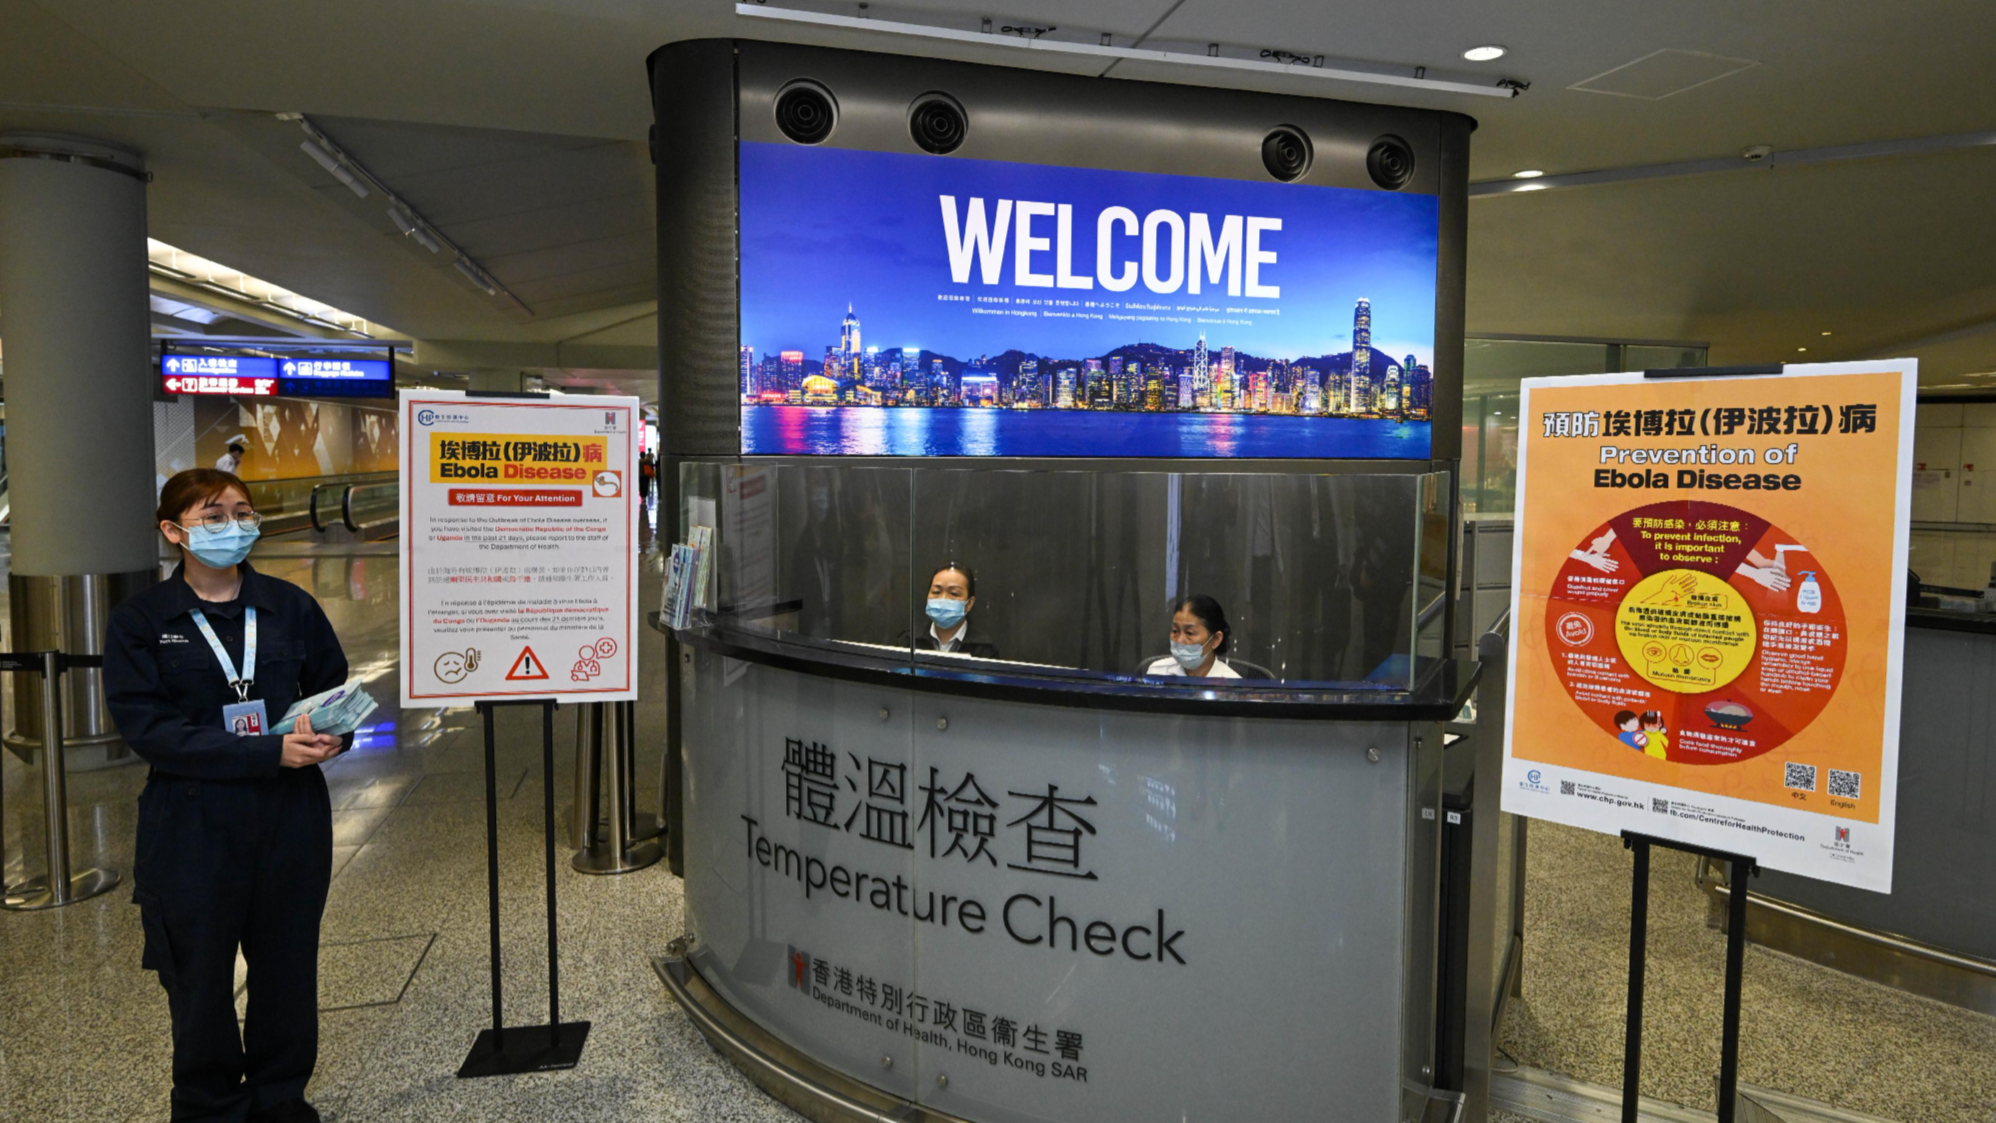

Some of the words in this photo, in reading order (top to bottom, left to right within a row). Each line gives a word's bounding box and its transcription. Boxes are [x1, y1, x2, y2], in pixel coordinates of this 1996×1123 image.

[939, 195, 1282, 298] WELCOME
[1600, 444, 1756, 464] Prevention
[1764, 443, 1798, 464] of
[440, 463, 498, 479] Ebola
[504, 464, 586, 480] Disease
[1594, 469, 1669, 489] Ebola
[1677, 469, 1802, 490] Disease
[497, 494, 511, 502] For
[513, 494, 534, 503] Your
[535, 495, 575, 503] Attention
[1641, 531, 1652, 539] To
[1654, 532, 1691, 541] prevent
[1693, 532, 1742, 544] infection,
[1655, 542, 1662, 550] it
[1675, 543, 1724, 553] important
[1672, 553, 1712, 563] observe
[1566, 628, 1587, 637] Avoid
[1577, 792, 1644, 809] www.chp.gov.hk
[1792, 792, 1806, 801] 中文
[1830, 799, 1855, 809] English
[781, 736, 1098, 881] 體溫檢查
[1670, 809, 1805, 842] fb.com/CentreforHealthProtection
[741, 814, 987, 935] Temperature
[1002, 893, 1187, 966] Check
[812, 986, 882, 1026] Department
[886, 1018, 900, 1032] of
[904, 1021, 952, 1051] Health,
[957, 1038, 998, 1065] Hong
[1004, 1051, 1045, 1077] Kong
[1052, 1062, 1087, 1083] SAR
